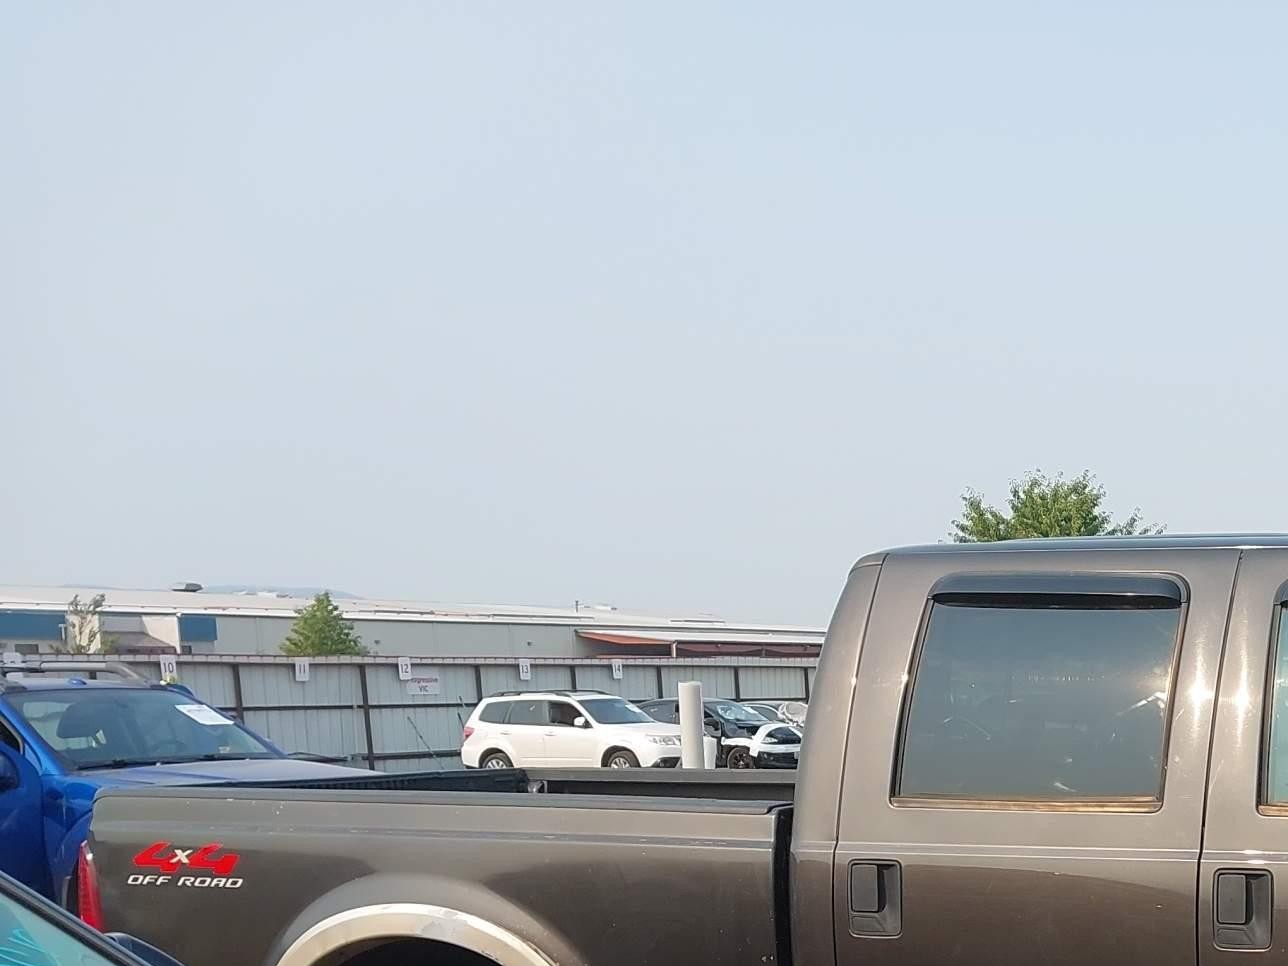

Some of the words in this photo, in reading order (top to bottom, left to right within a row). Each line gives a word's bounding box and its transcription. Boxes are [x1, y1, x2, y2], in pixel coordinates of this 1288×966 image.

[162, 662, 174, 674] 10
[400, 663, 409, 674] 12
[520, 664, 529, 674] 13
[613, 664, 621, 673] 14
[127, 874, 172, 886] OFF
[177, 876, 244, 889] ROAD
